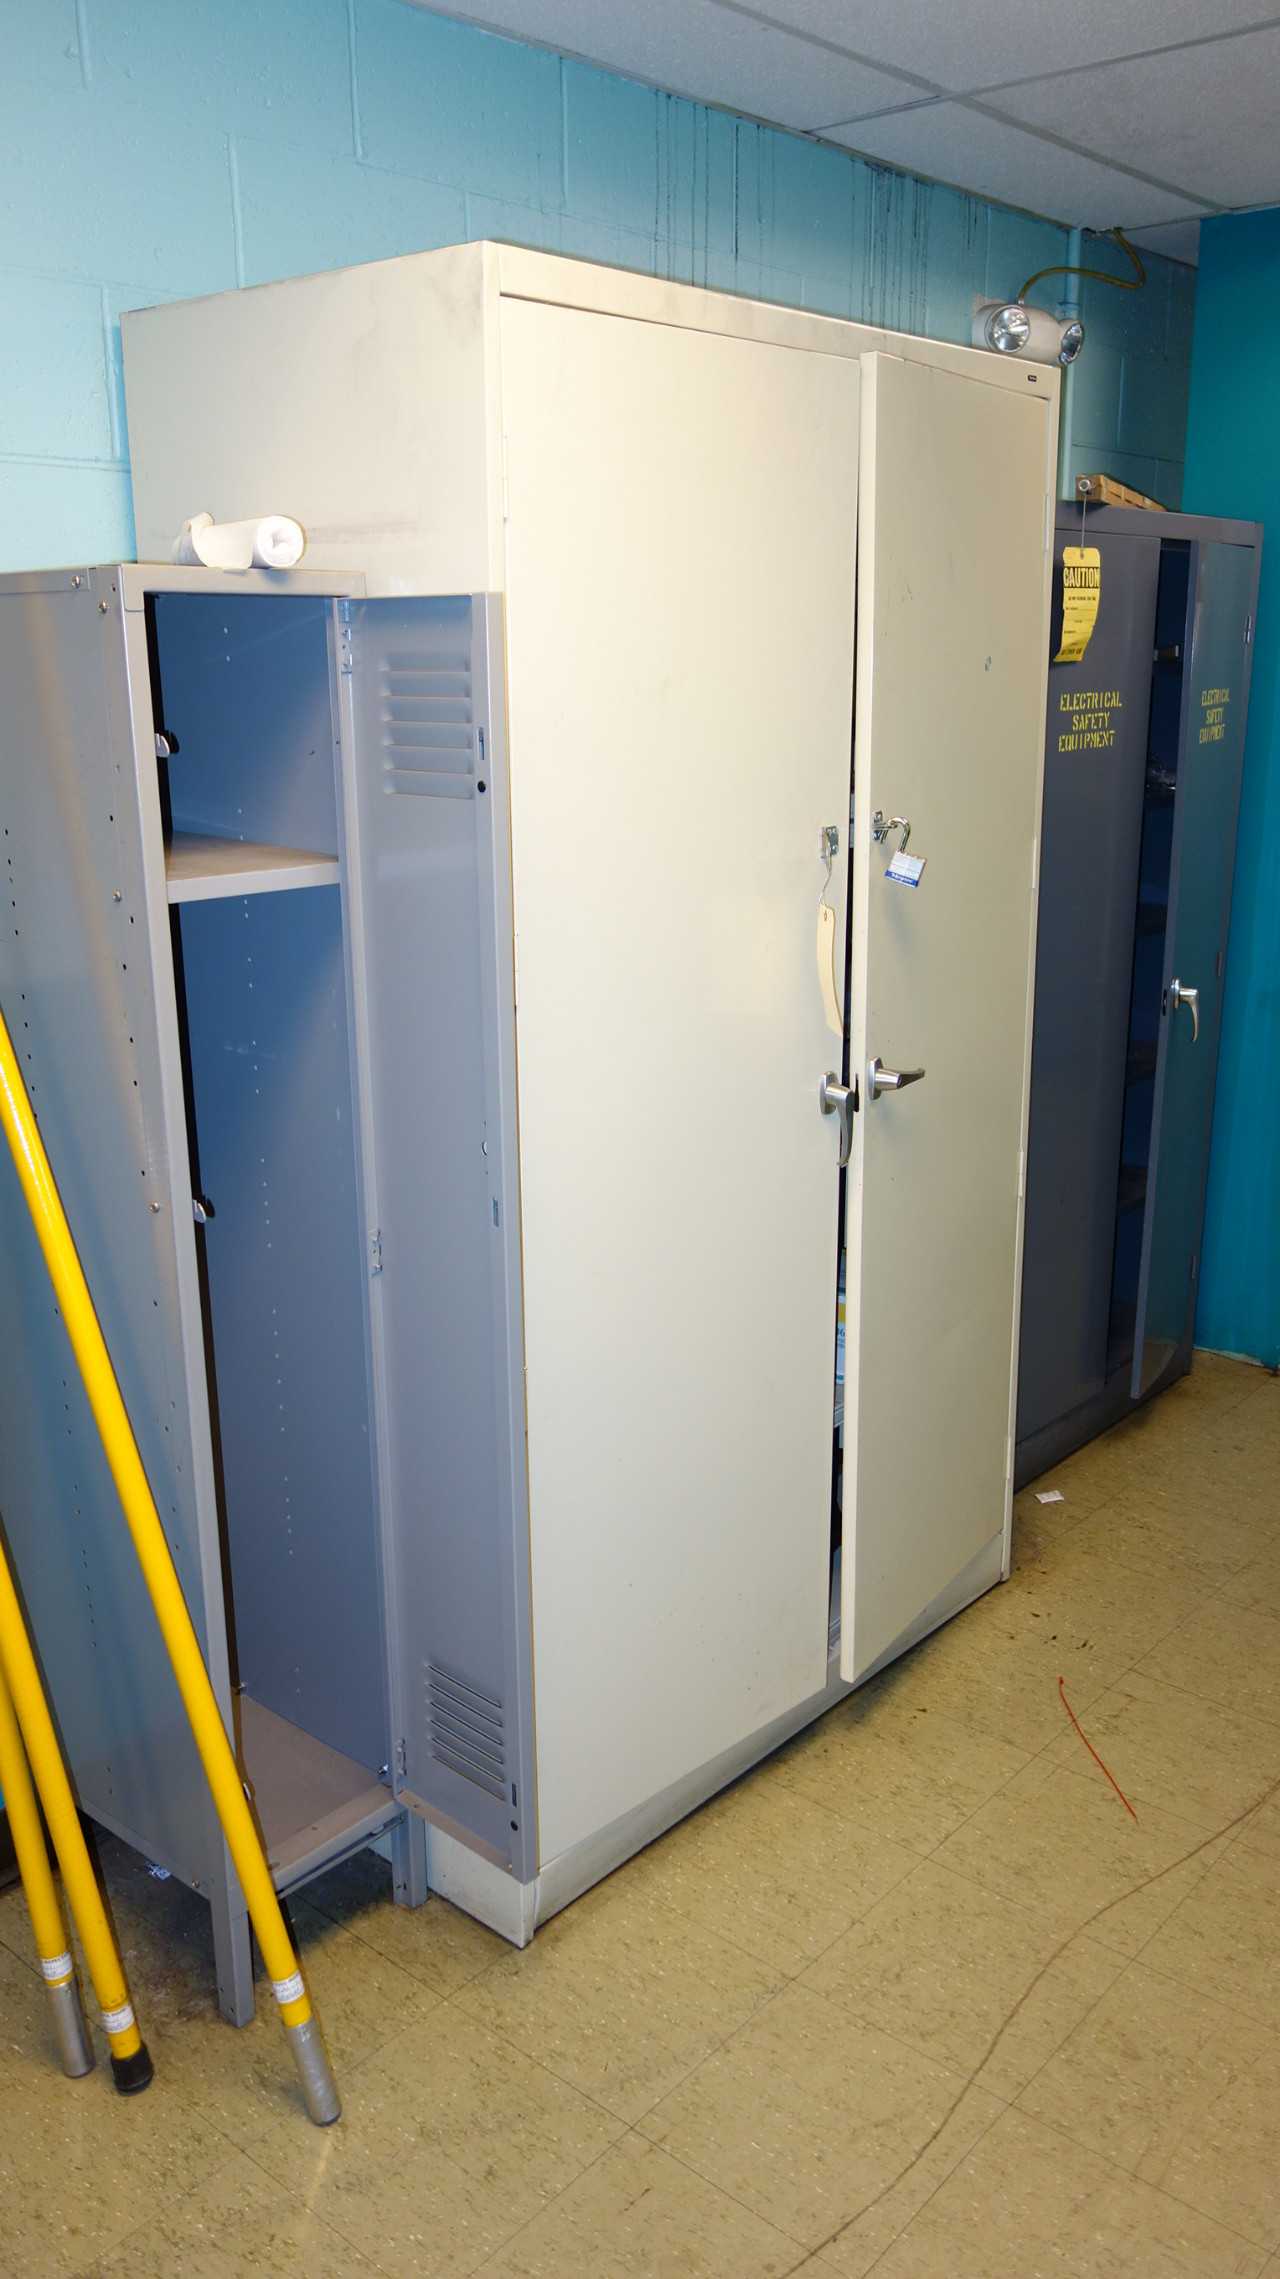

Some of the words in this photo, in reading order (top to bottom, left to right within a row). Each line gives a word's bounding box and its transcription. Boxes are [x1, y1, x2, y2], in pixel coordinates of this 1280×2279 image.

[1063, 567, 1100, 587] CAUTION
[1059, 691, 1122, 711] ELECTRICAL
[1072, 712, 1110, 731] SAFETY
[1058, 730, 1115, 753] EQUIPMENT
